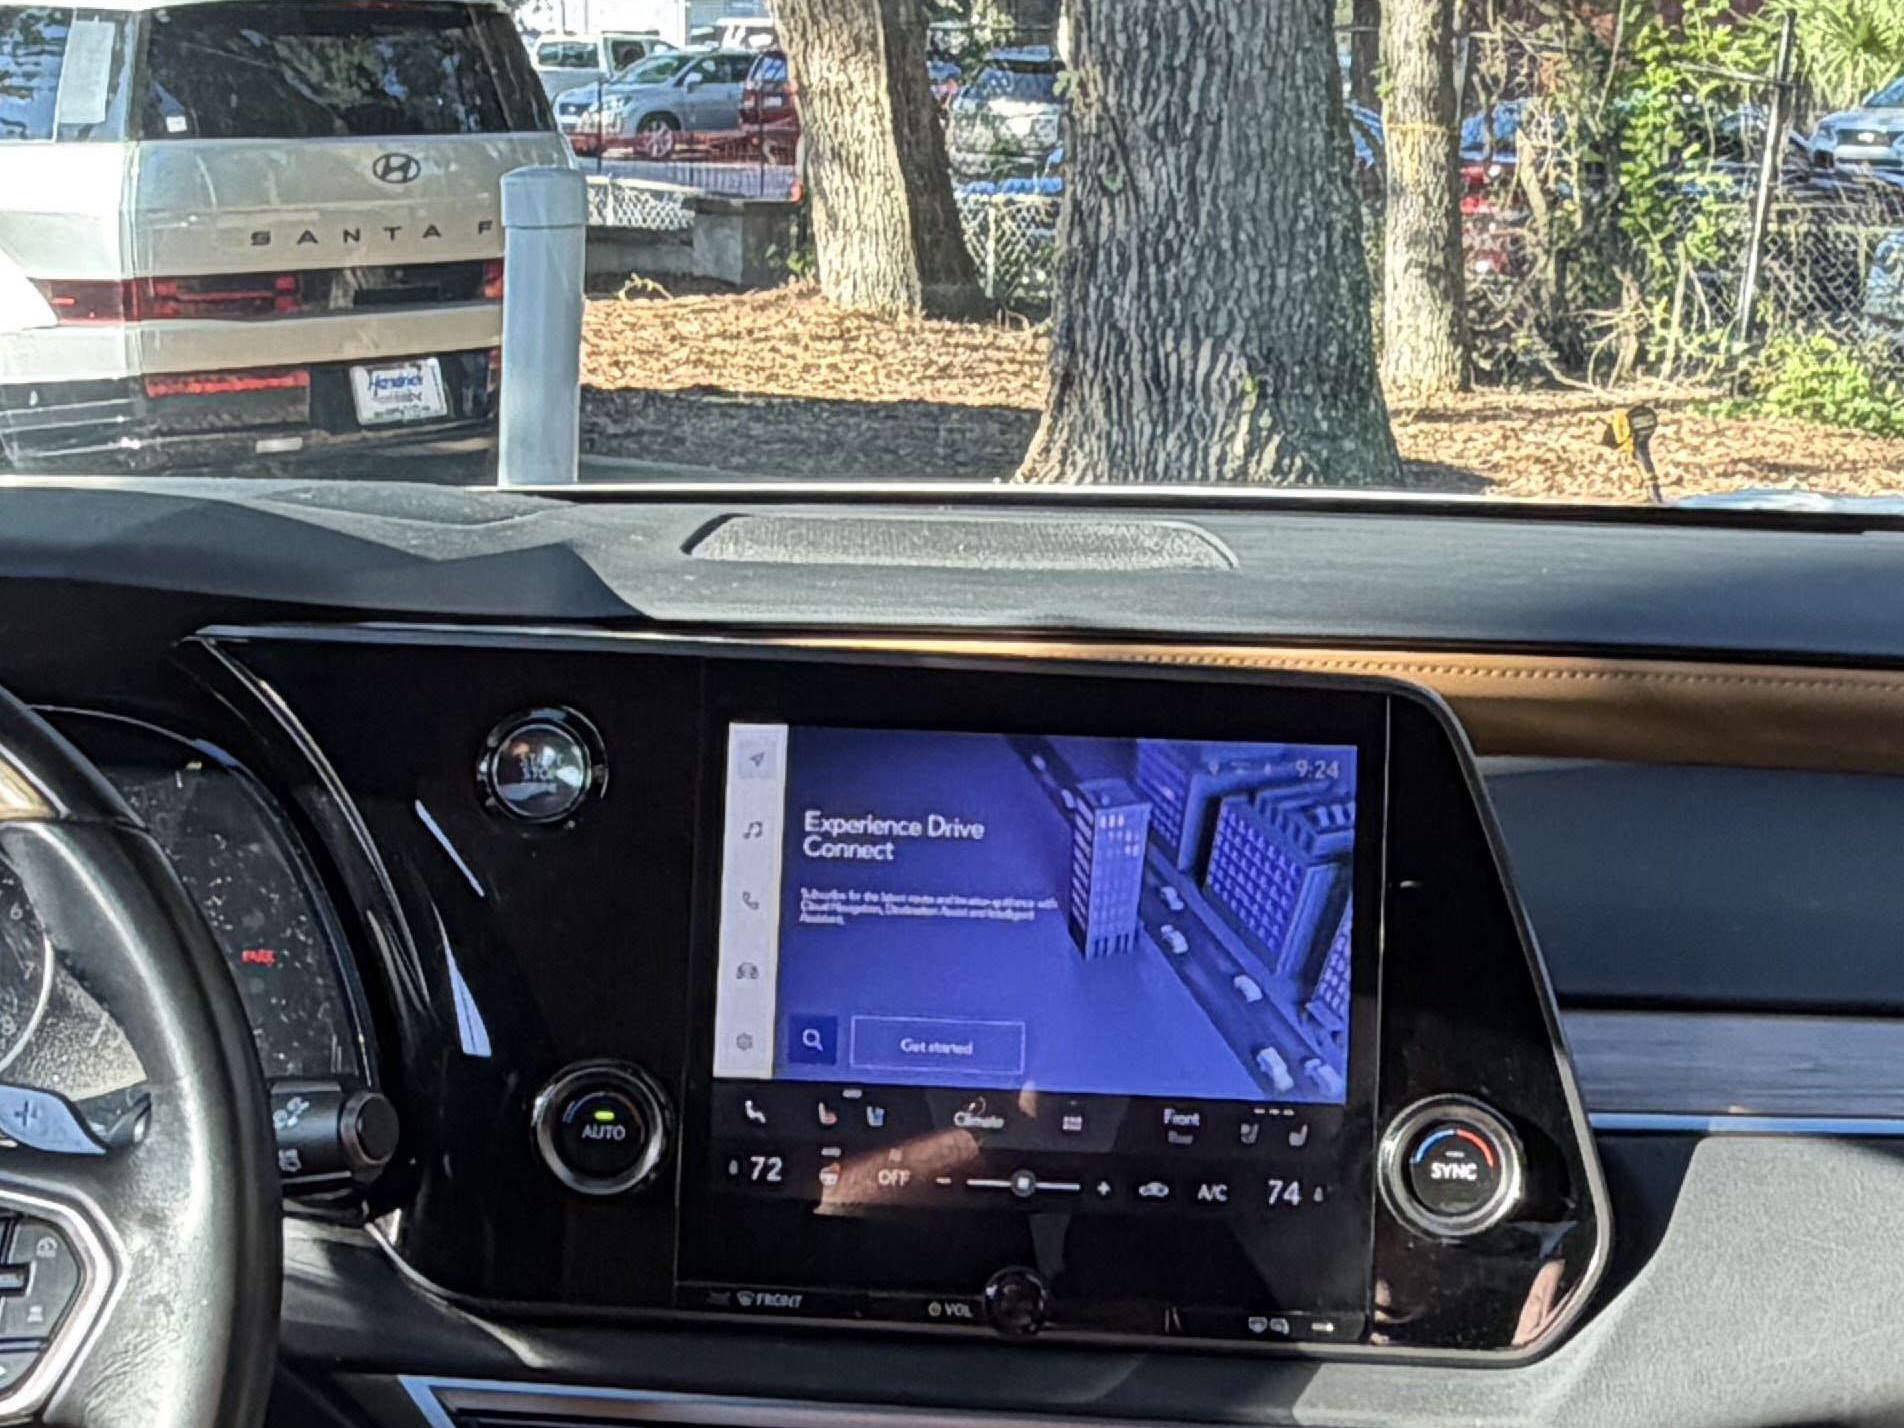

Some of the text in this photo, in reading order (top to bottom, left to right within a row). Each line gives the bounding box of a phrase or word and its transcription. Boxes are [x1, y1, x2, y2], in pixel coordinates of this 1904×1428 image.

[251, 223, 442, 246] SANTA
[1294, 759, 1341, 780] 9:24
[803, 810, 985, 841] Experience Drive
[802, 836, 896, 862] Connect
[11, 904, 24, 921] 6
[901, 1038, 974, 1055] Get started
[953, 1111, 1005, 1126] Climate
[1164, 1108, 1201, 1126] Front
[581, 1124, 626, 1141] AUTO
[751, 1157, 783, 1183] 72
[878, 1169, 910, 1186] OFF
[1430, 1162, 1478, 1181] SYNC
[1197, 1182, 1229, 1203] A/C
[1268, 1178, 1302, 1206] 74
[754, 1293, 803, 1310] FRONT
[944, 1302, 973, 1319] VOL
